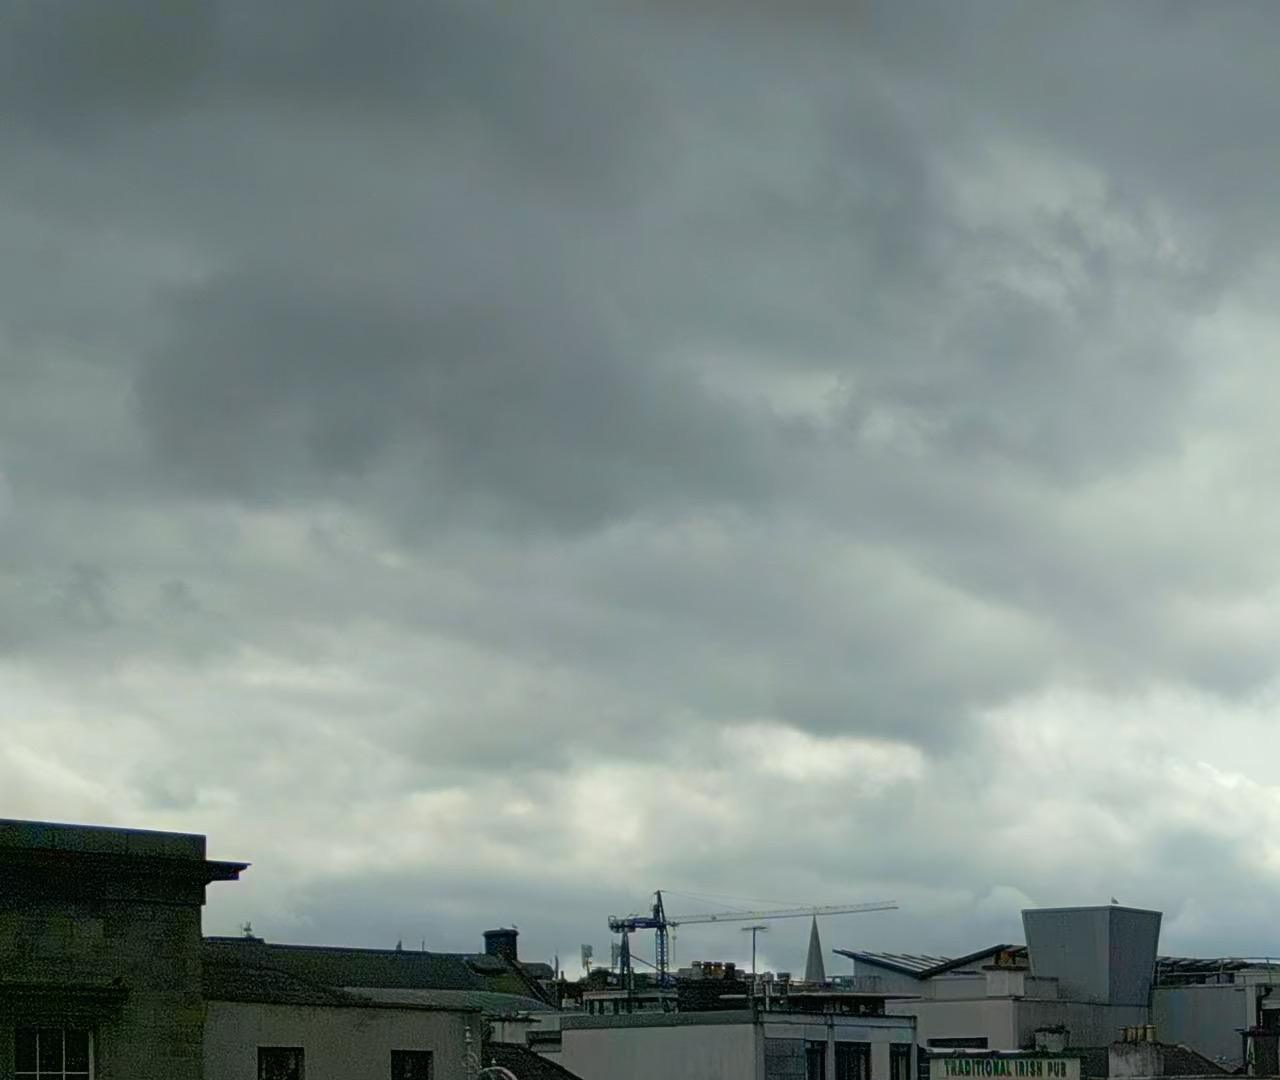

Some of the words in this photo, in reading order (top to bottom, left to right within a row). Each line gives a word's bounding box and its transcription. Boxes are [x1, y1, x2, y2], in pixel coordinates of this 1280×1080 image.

[944, 1060, 1012, 1077] TRADITIONAL
[1015, 1060, 1043, 1077] IRISH
[1047, 1061, 1067, 1078] PUB
